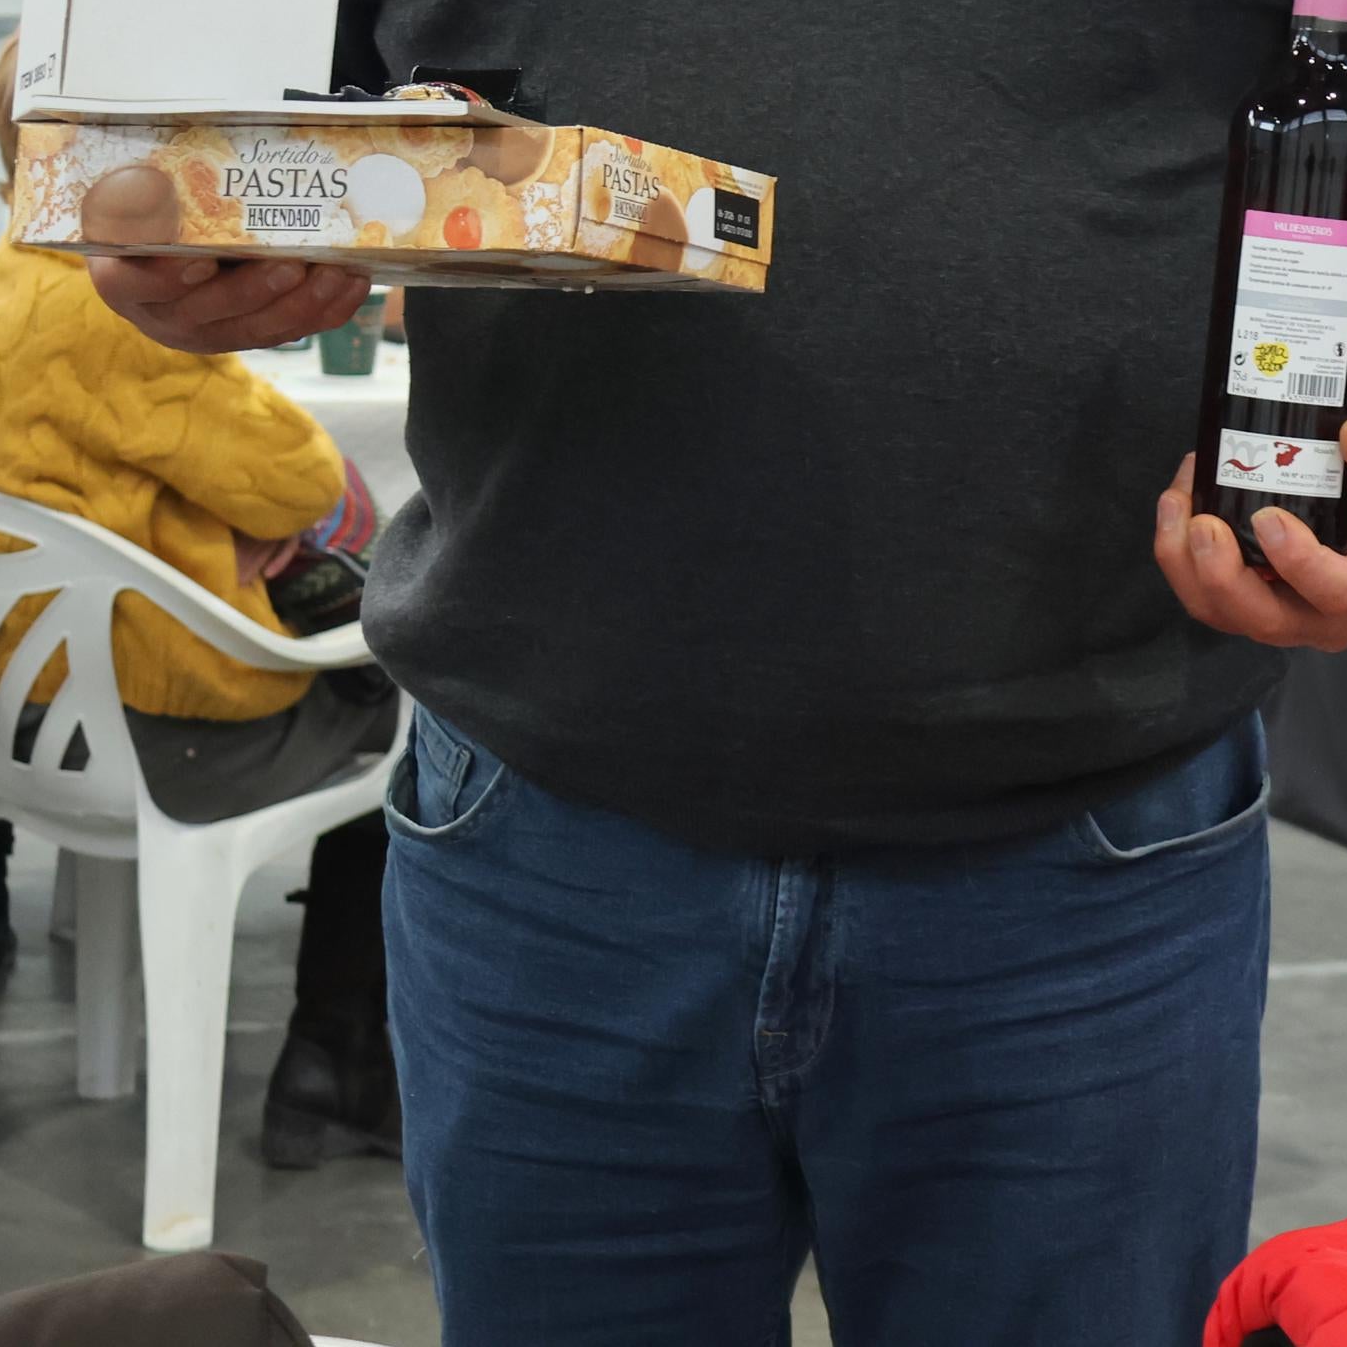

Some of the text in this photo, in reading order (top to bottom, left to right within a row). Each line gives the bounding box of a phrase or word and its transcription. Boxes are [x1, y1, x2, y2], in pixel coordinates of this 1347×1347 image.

[240, 138, 334, 164] Sortido de
[609, 144, 646, 169] Sortido
[223, 167, 349, 199] PASTAS
[602, 163, 660, 202] PASTAS
[247, 207, 321, 228] HACENDADO
